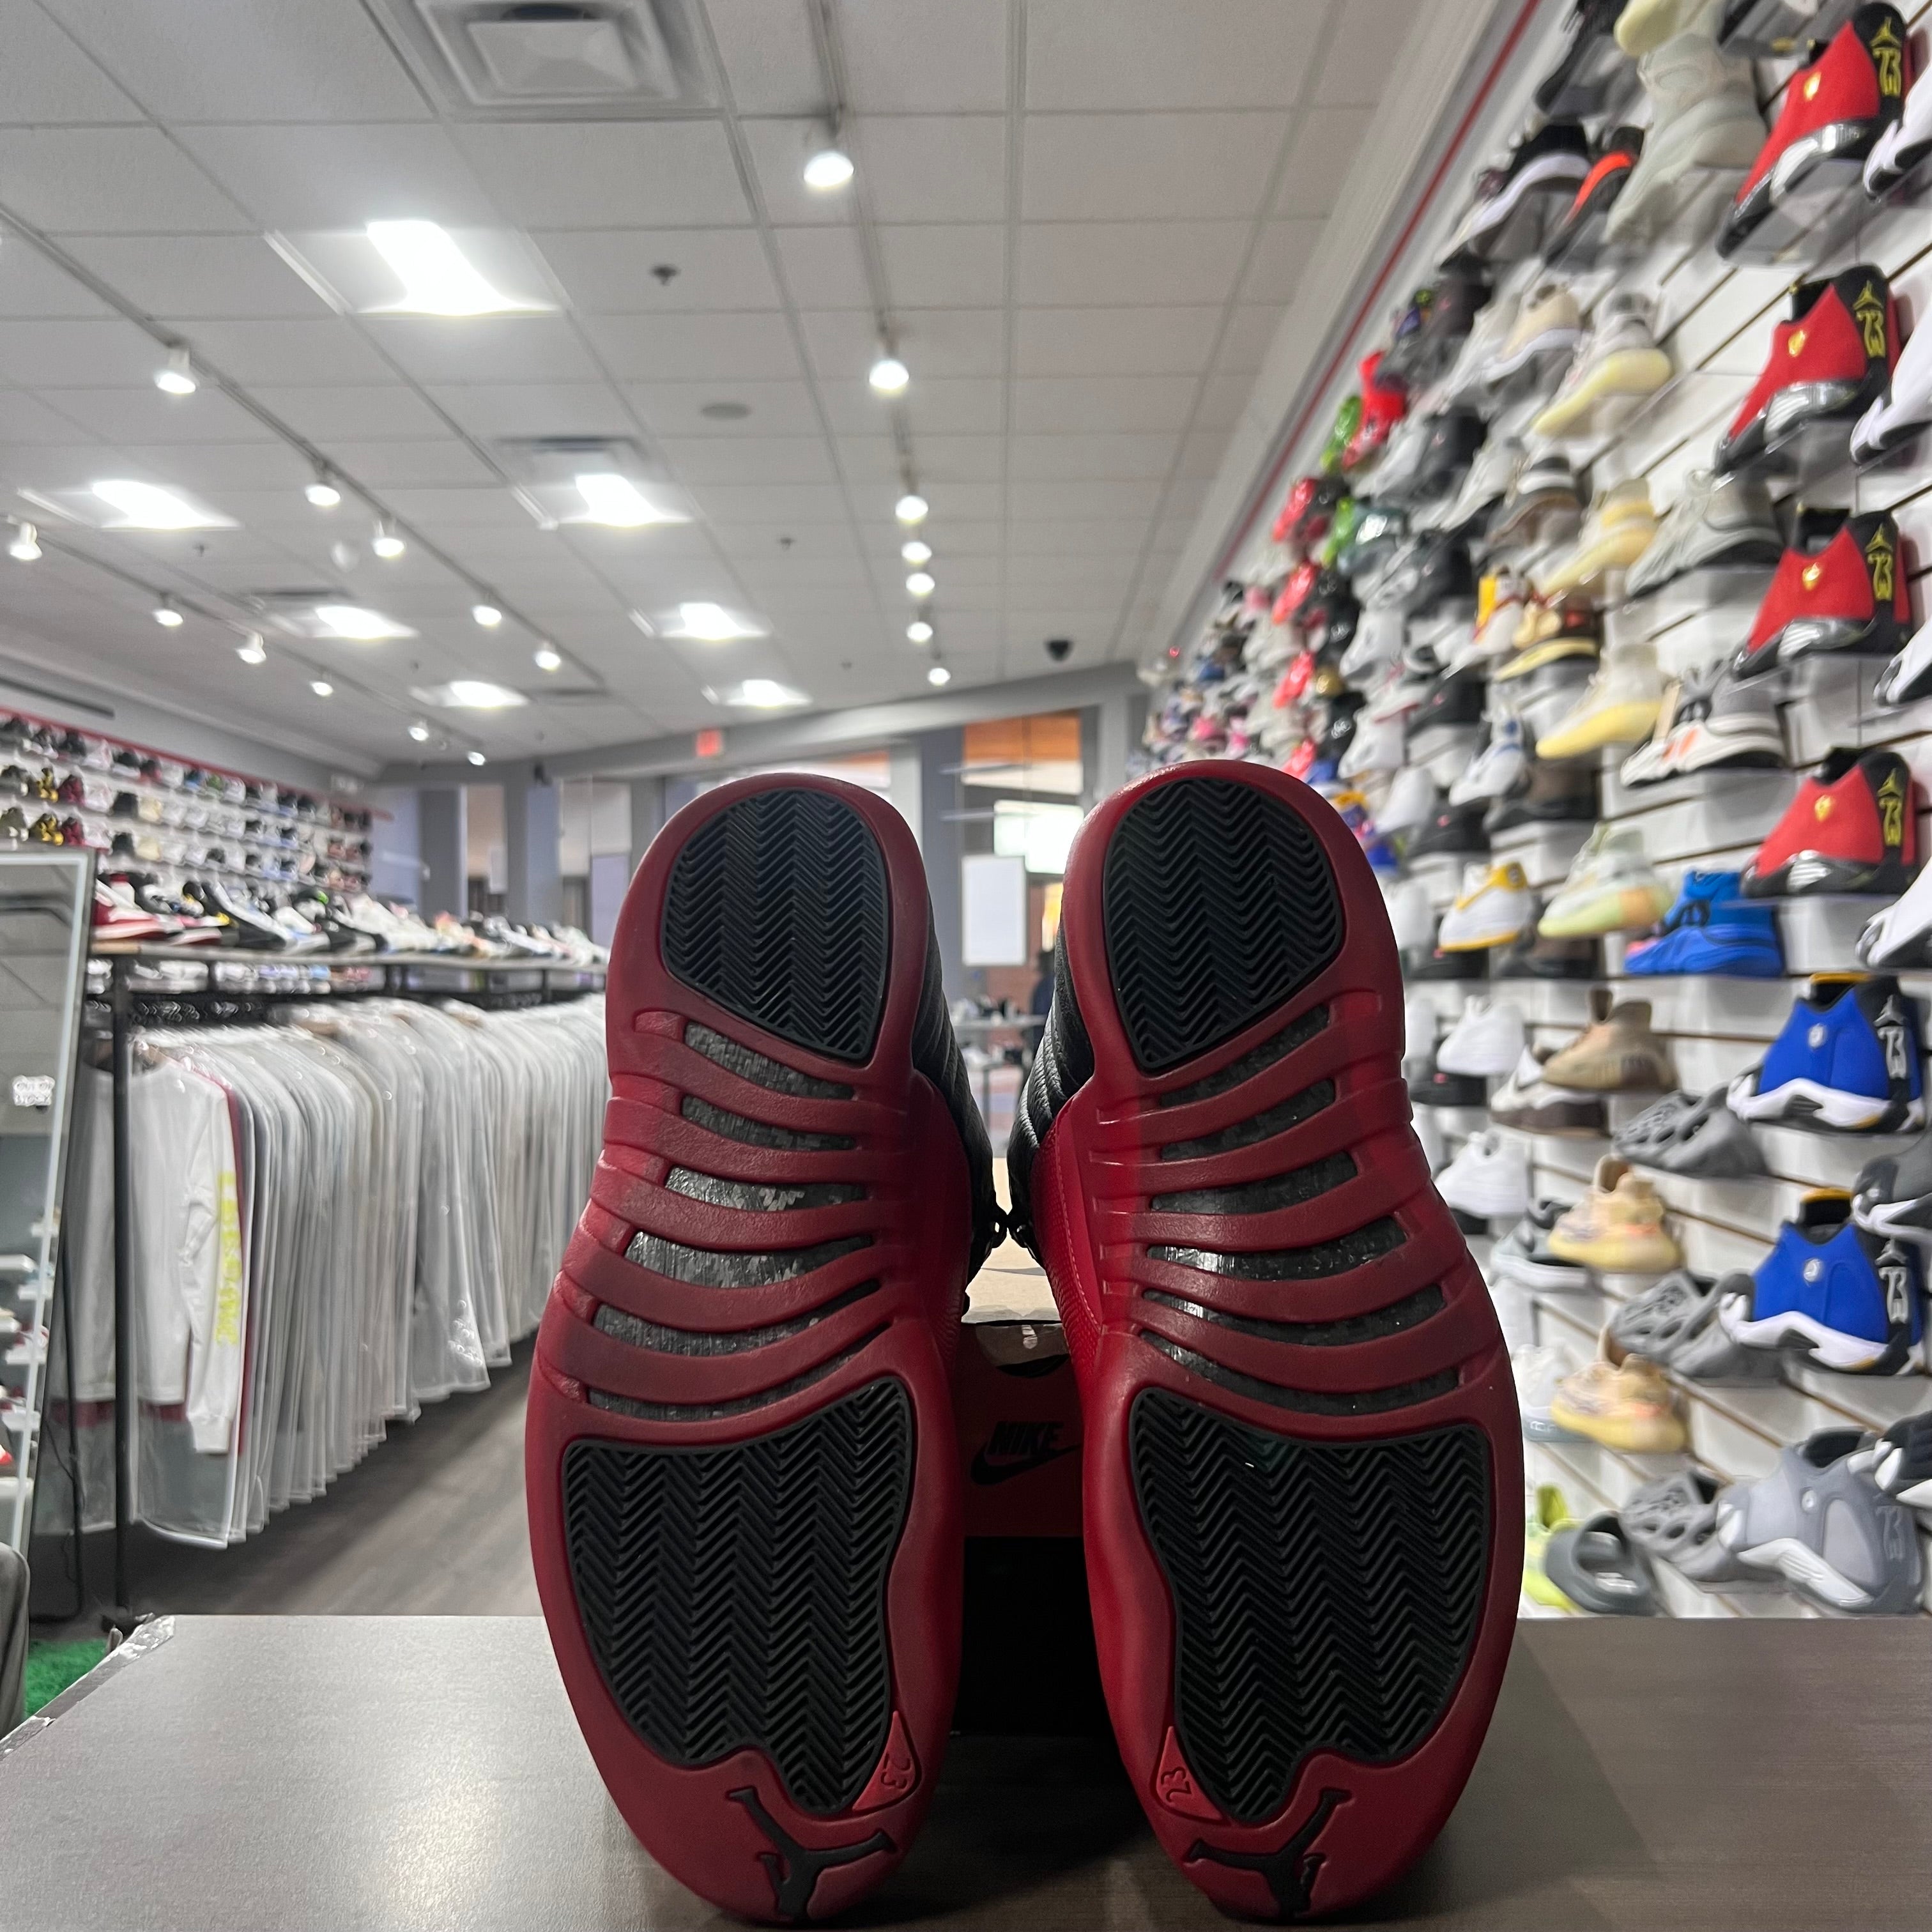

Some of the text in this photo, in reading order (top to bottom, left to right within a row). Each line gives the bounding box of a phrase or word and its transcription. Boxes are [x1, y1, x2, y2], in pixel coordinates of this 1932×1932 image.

[985, 1420, 1065, 1456] NIKE
[880, 1752, 911, 1788] 23
[1160, 1767, 1192, 1802] 23
